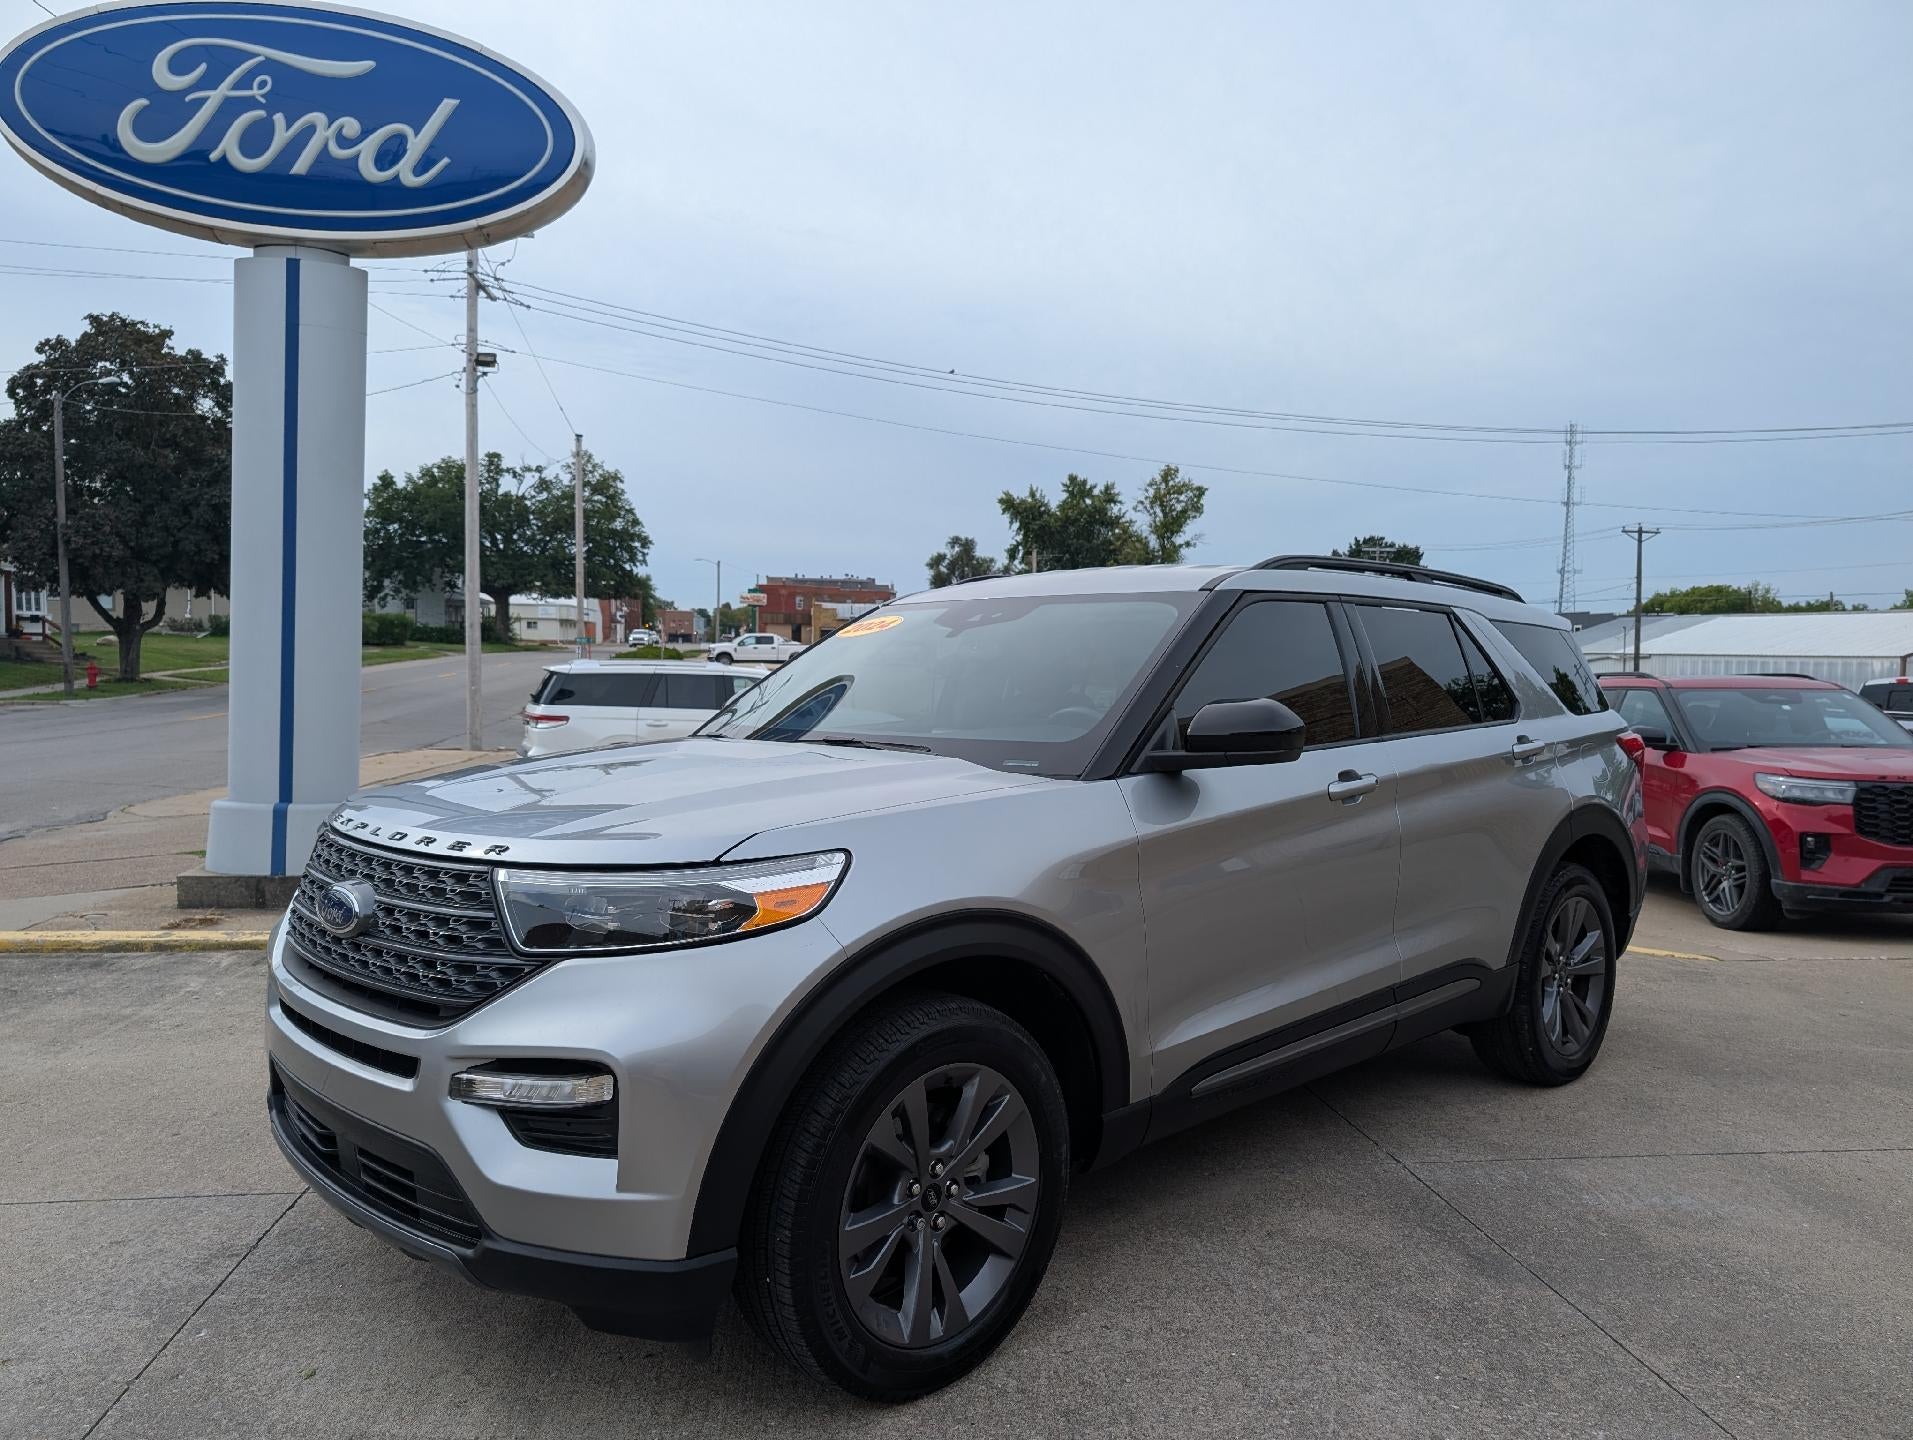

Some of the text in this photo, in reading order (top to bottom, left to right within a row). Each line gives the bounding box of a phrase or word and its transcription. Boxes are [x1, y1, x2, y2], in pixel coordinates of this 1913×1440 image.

[116, 36, 461, 188] Ford
[333, 814, 511, 856] EXPLORER
[816, 1248, 848, 1342] MICHELIN
